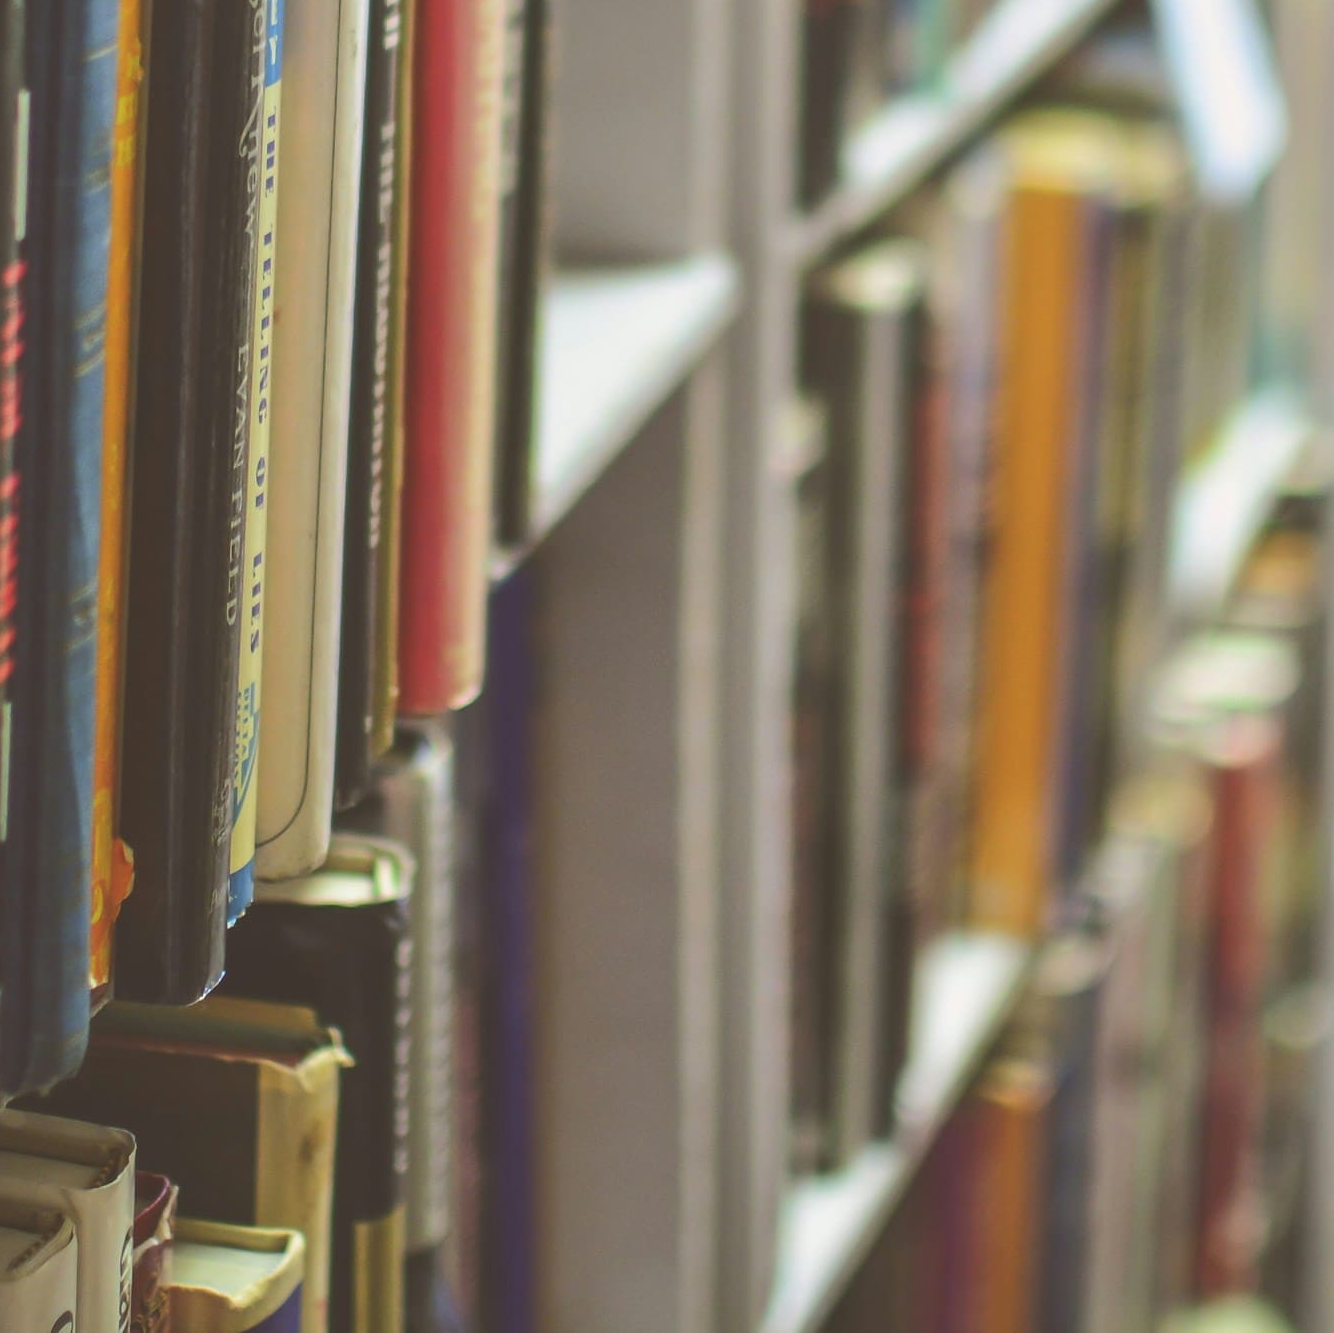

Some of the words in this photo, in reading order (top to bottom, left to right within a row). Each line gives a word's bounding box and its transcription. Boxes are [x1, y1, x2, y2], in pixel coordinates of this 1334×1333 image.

[265, 108, 277, 197] THE
[257, 222, 273, 425] TELLING
[232, 342, 251, 470] EVAN
[254, 456, 268, 511] OF
[225, 490, 244, 626] FIELD
[249, 551, 264, 654] LIES
